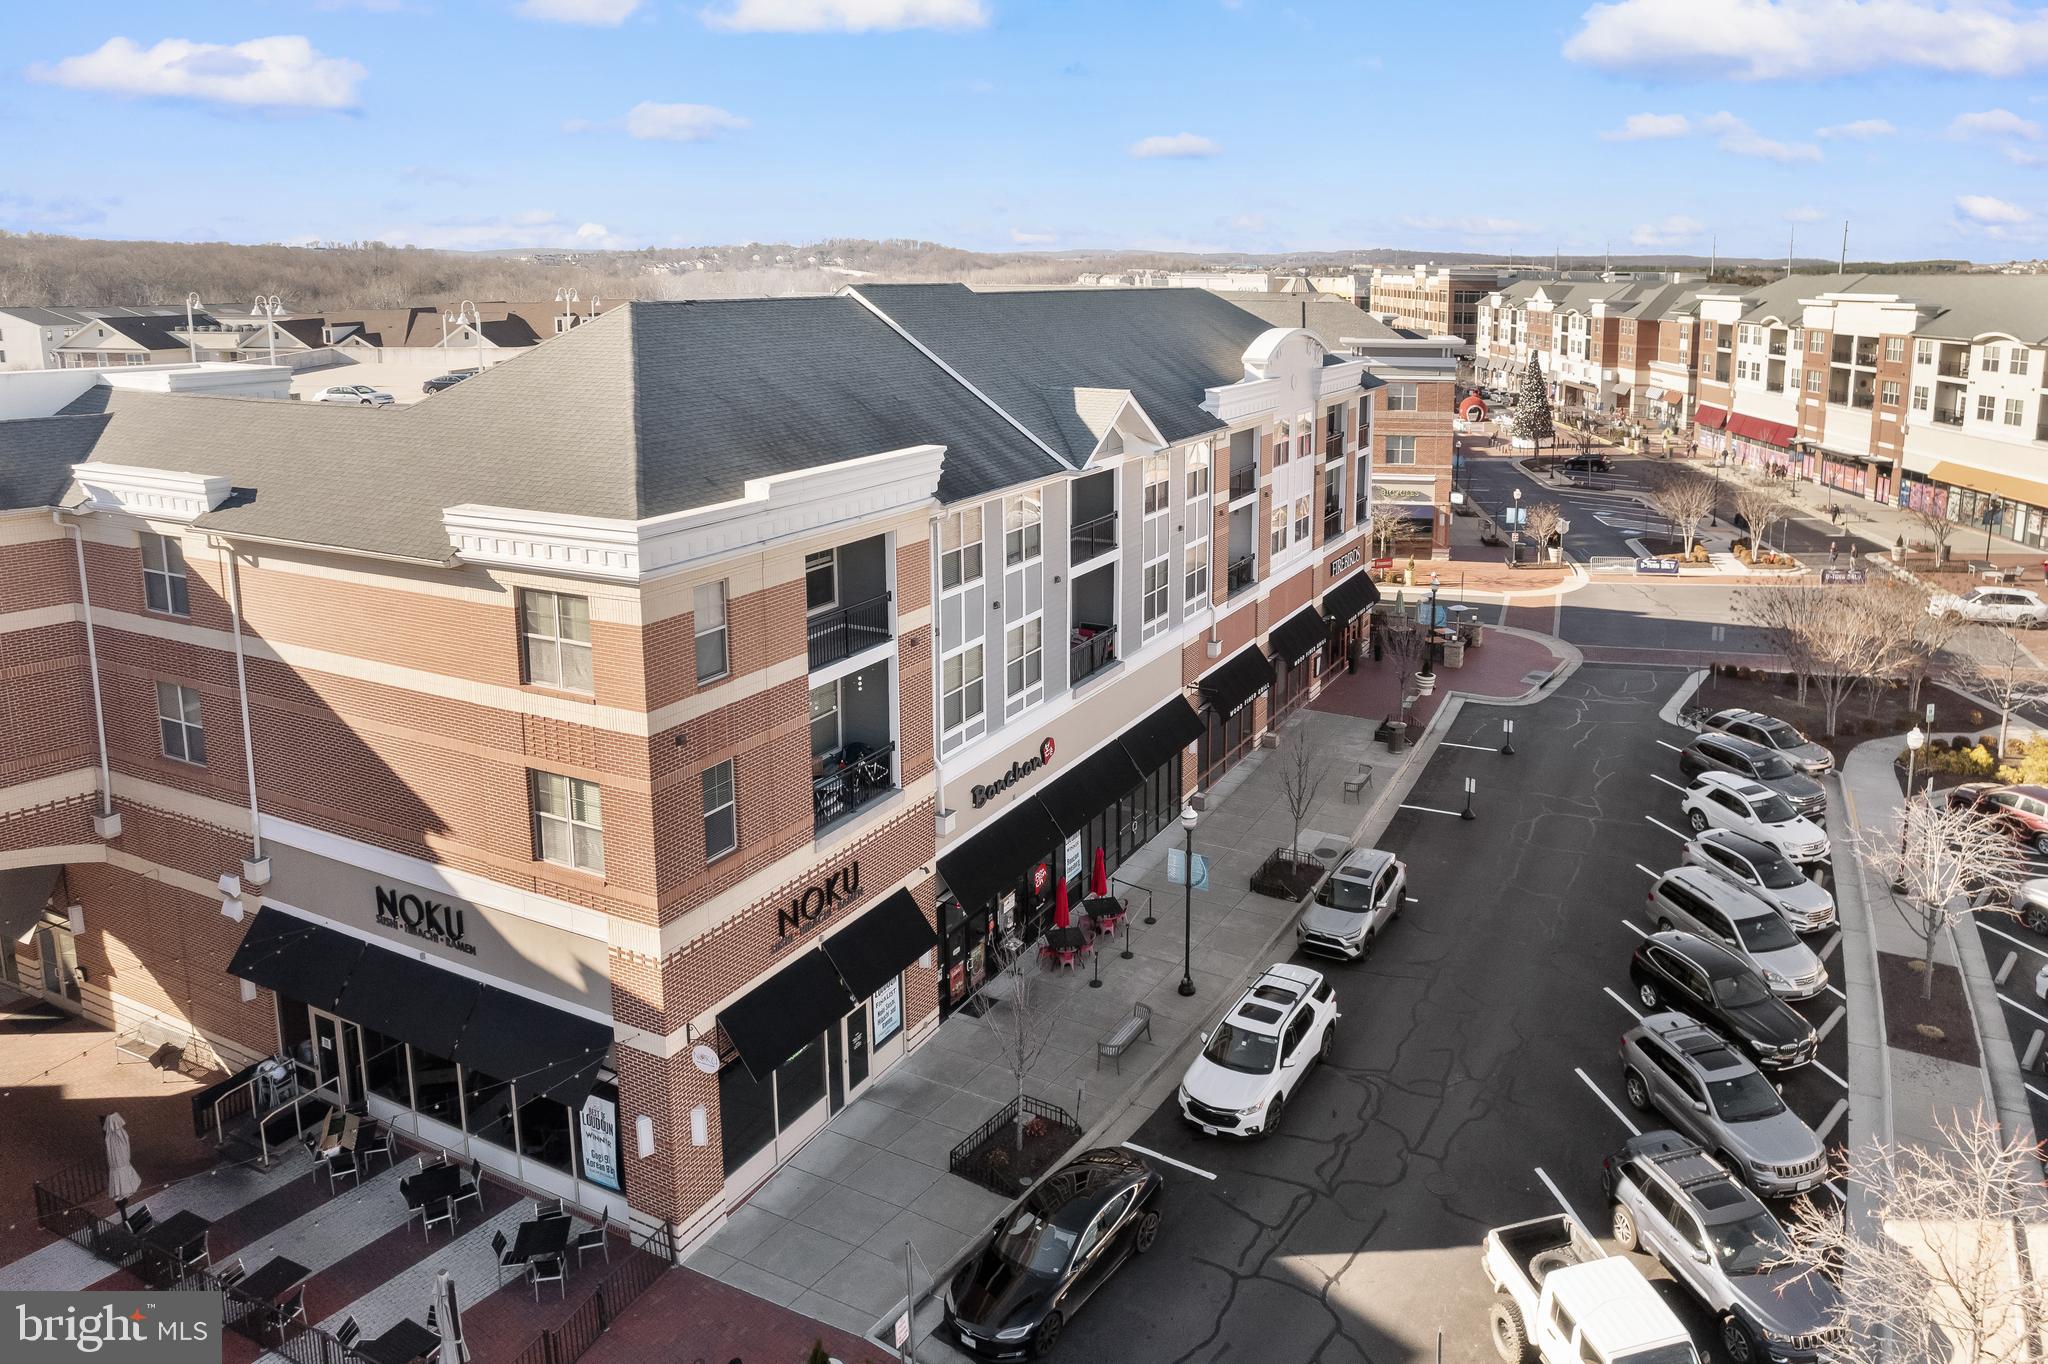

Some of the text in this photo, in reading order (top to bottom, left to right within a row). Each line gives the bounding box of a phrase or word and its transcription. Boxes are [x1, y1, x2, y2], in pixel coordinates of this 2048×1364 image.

[1331, 545, 1361, 577] FIREBIRDS
[1229, 682, 1270, 717] WOOD FIRED GRILL
[971, 756, 1043, 809] Bonchon
[376, 885, 465, 941] NOKU
[777, 860, 860, 938] NOKU
[582, 1112, 614, 1136] LOUDOUN
